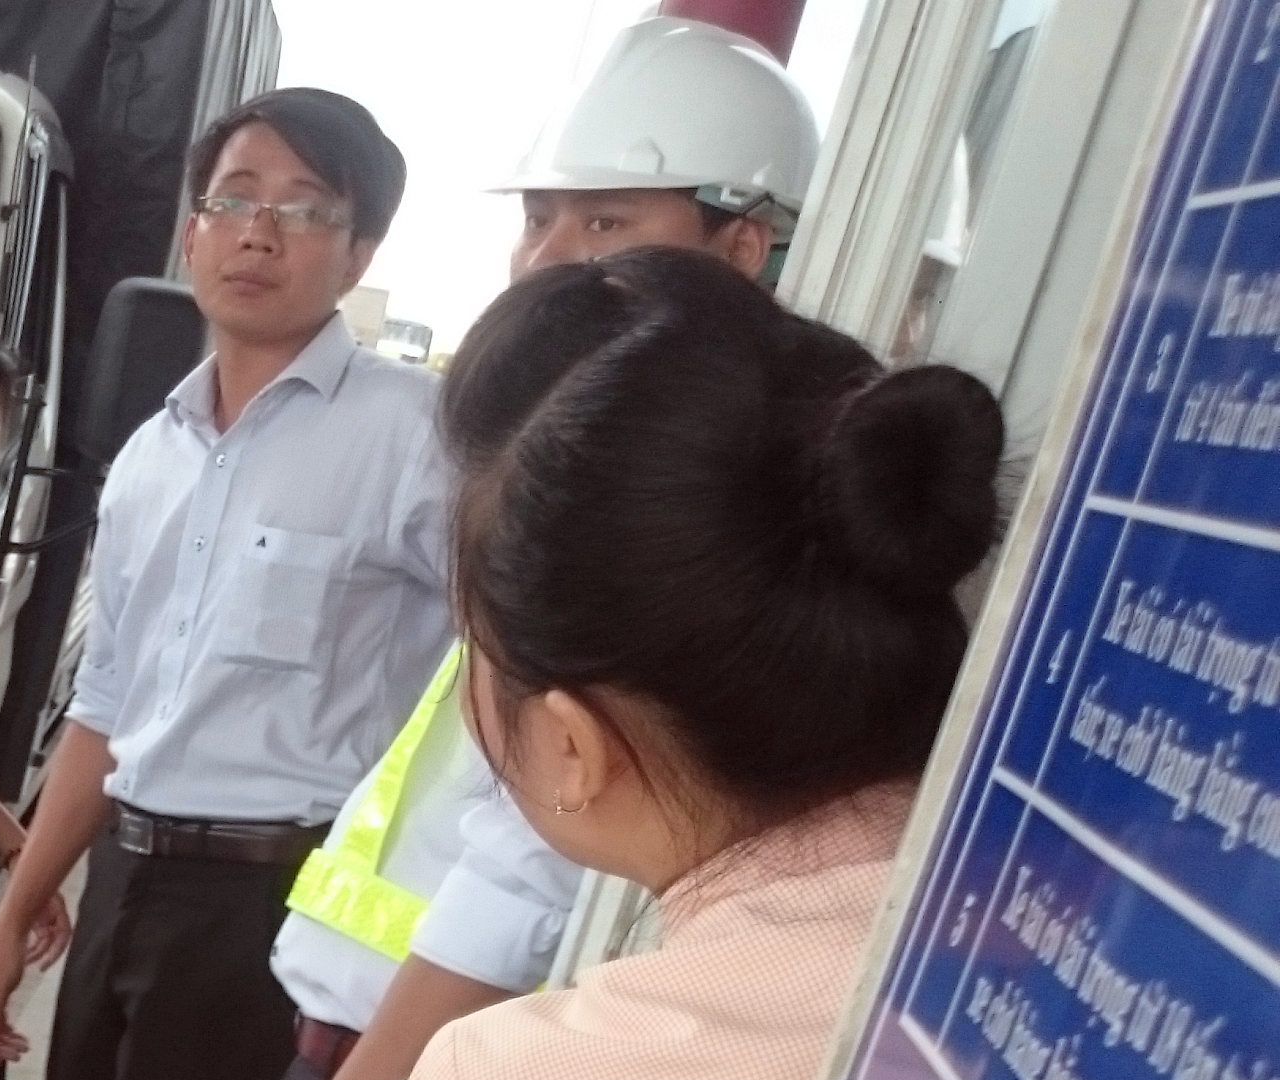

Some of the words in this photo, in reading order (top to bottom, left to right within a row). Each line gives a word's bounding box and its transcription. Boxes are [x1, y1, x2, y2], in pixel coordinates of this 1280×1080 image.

[1146, 334, 1174, 393] 3
[1046, 629, 1071, 684] 4
[1102, 579, 1135, 644] Xe
[1124, 586, 1163, 653] tải
[1145, 599, 1185, 662] có
[1168, 602, 1213, 674] tải
[1196, 618, 1268, 714] trọng
[1115, 706, 1163, 777] chở
[1145, 717, 1210, 821] hàng
[1194, 733, 1262, 852] bằng
[949, 894, 976, 947] 5
[1003, 866, 1032, 931] Xe
[1017, 884, 1054, 950] tải
[1035, 906, 1072, 965] có
[1054, 916, 1097, 988] tải
[982, 981, 1022, 1049] chở
[1077, 940, 1141, 1047] trọng
